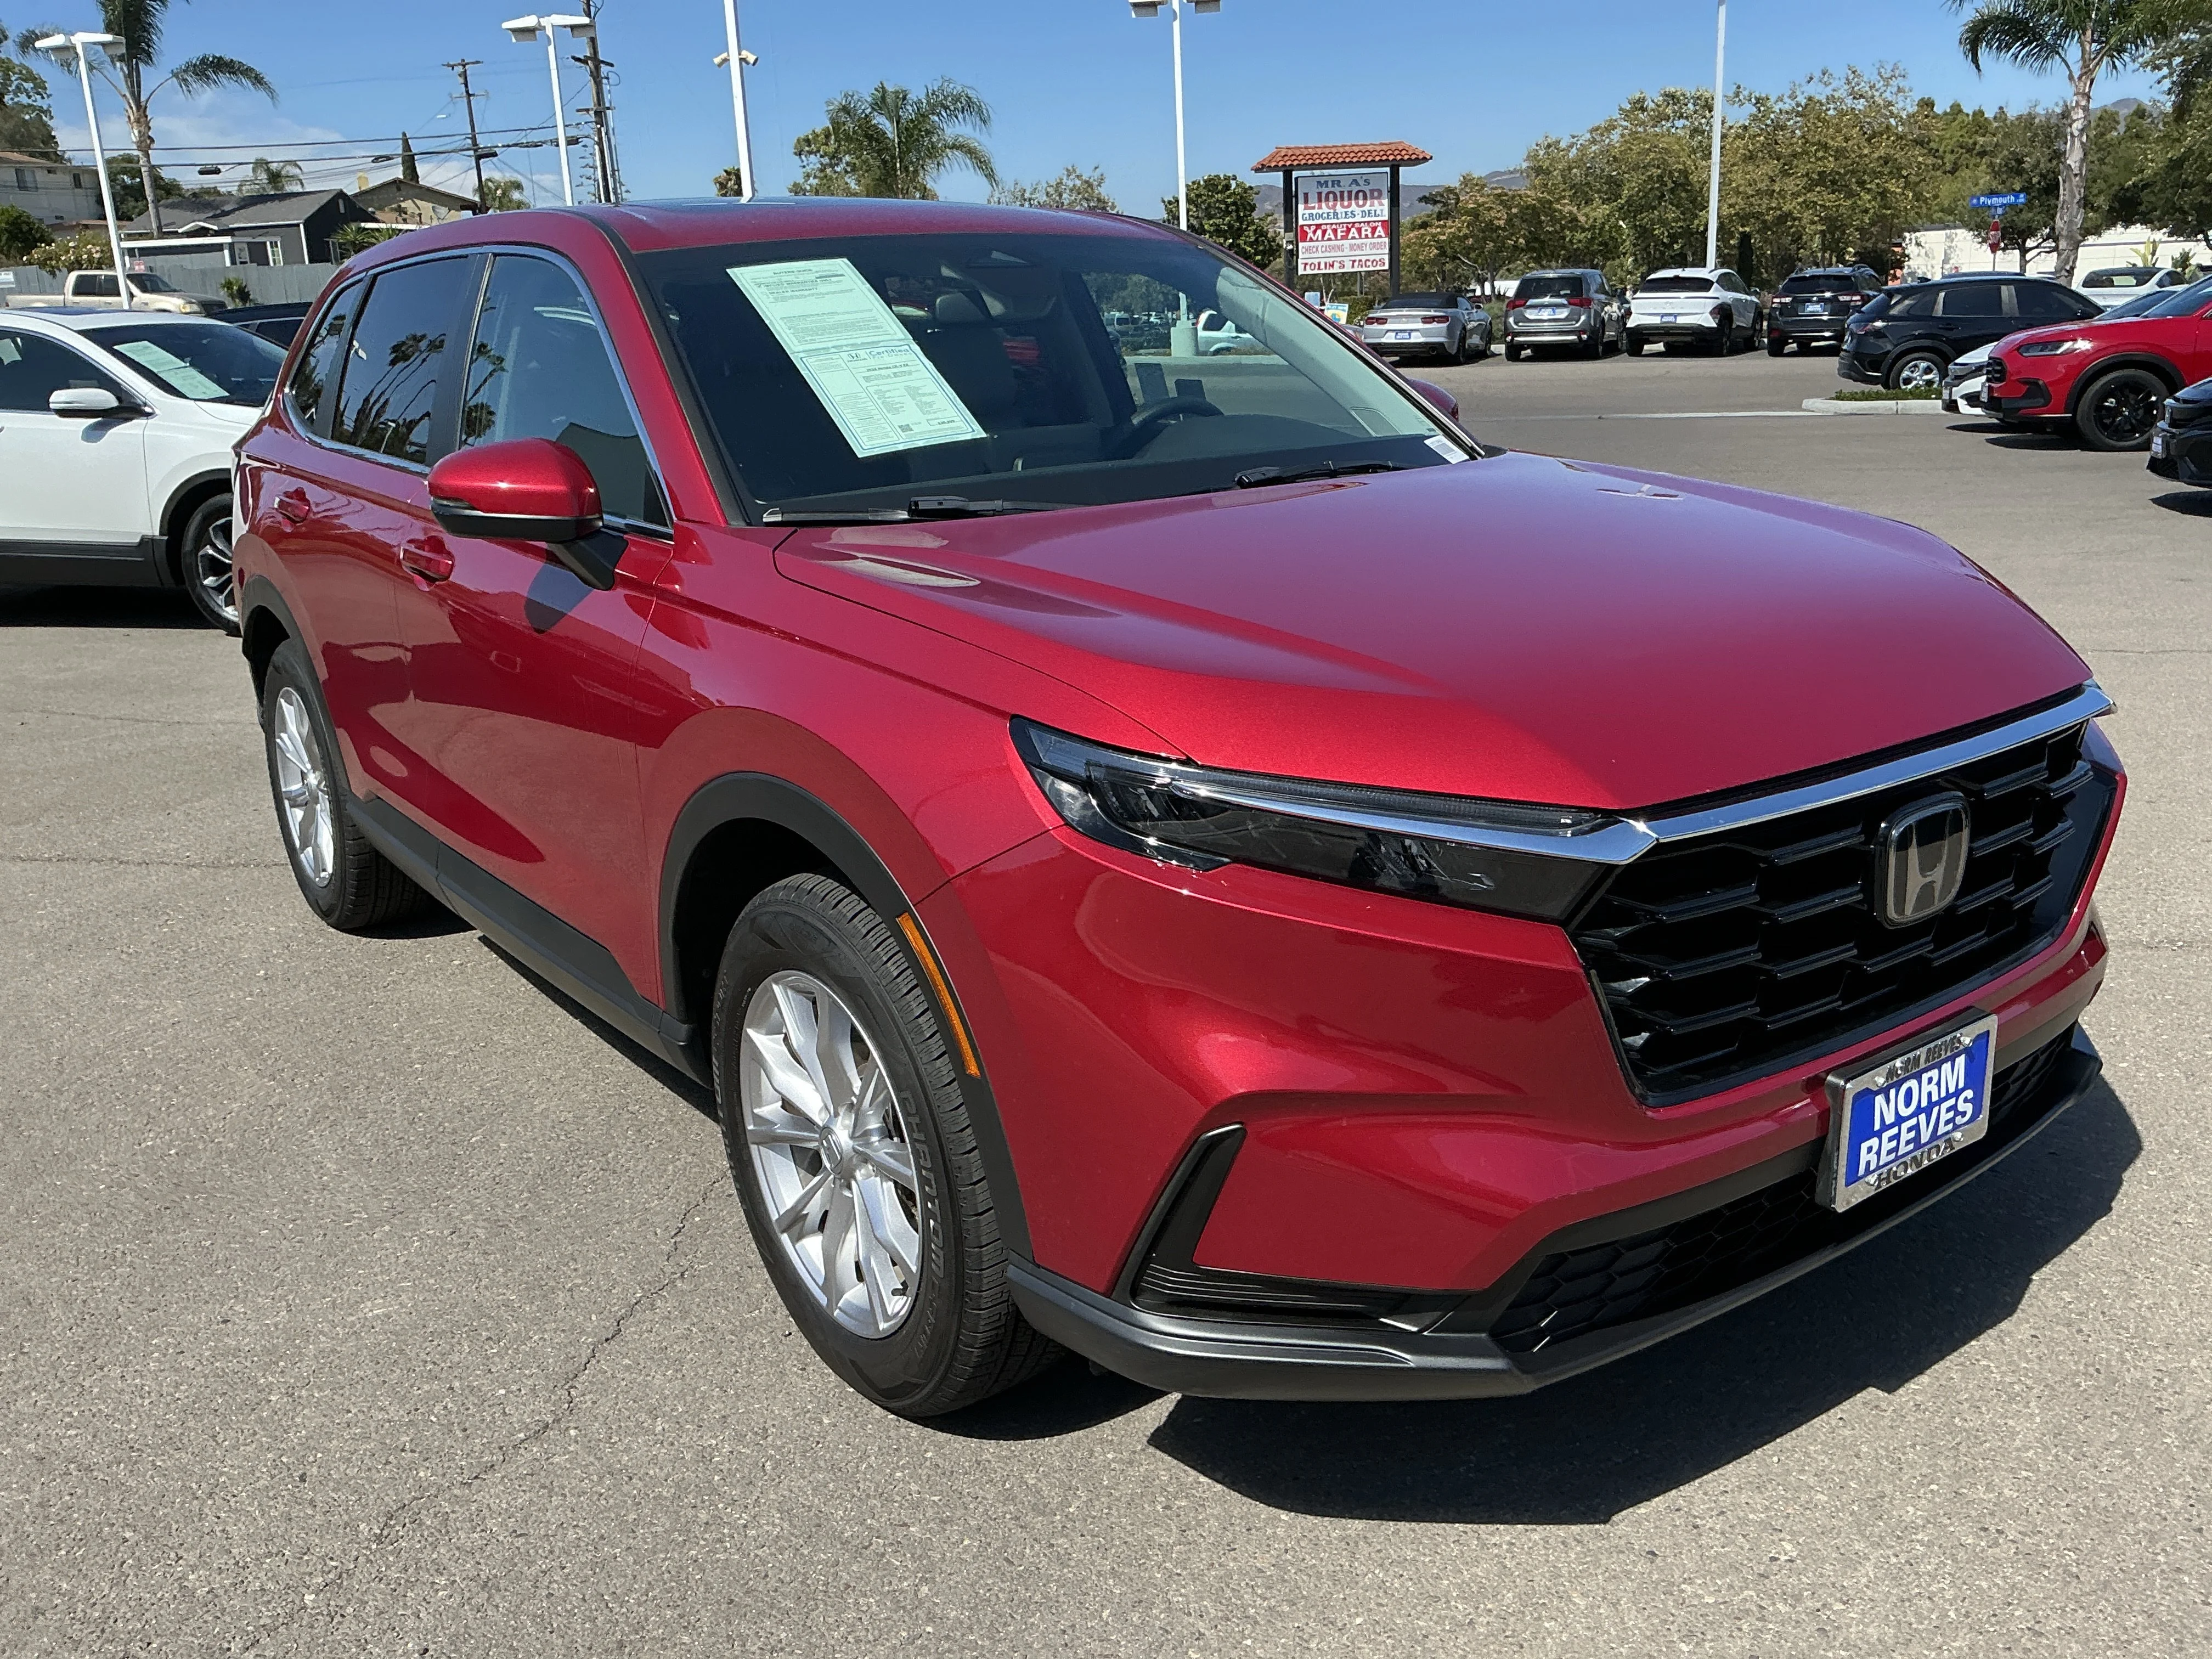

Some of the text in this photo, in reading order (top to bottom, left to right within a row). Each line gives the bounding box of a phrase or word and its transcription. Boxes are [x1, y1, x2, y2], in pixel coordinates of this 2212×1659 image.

[1316, 179, 1346, 189] MR.
[1303, 188, 1385, 211] LIQUOR
[1979, 195, 2015, 205] Plymouth
[1305, 226, 1386, 241] MAFARA
[1301, 245, 1319, 255] CHECK
[1321, 243, 1345, 254] CASHING
[1349, 242, 1368, 252] MONEY
[1369, 241, 1387, 251] ORDER
[1301, 257, 1386, 272] TOLIN'S TACOS
[868, 348, 910, 357] Certified
[1874, 1053, 1966, 1132] NORM
[1857, 1088, 1975, 1177] REEVES
[1874, 1136, 1956, 1191] HONDA
